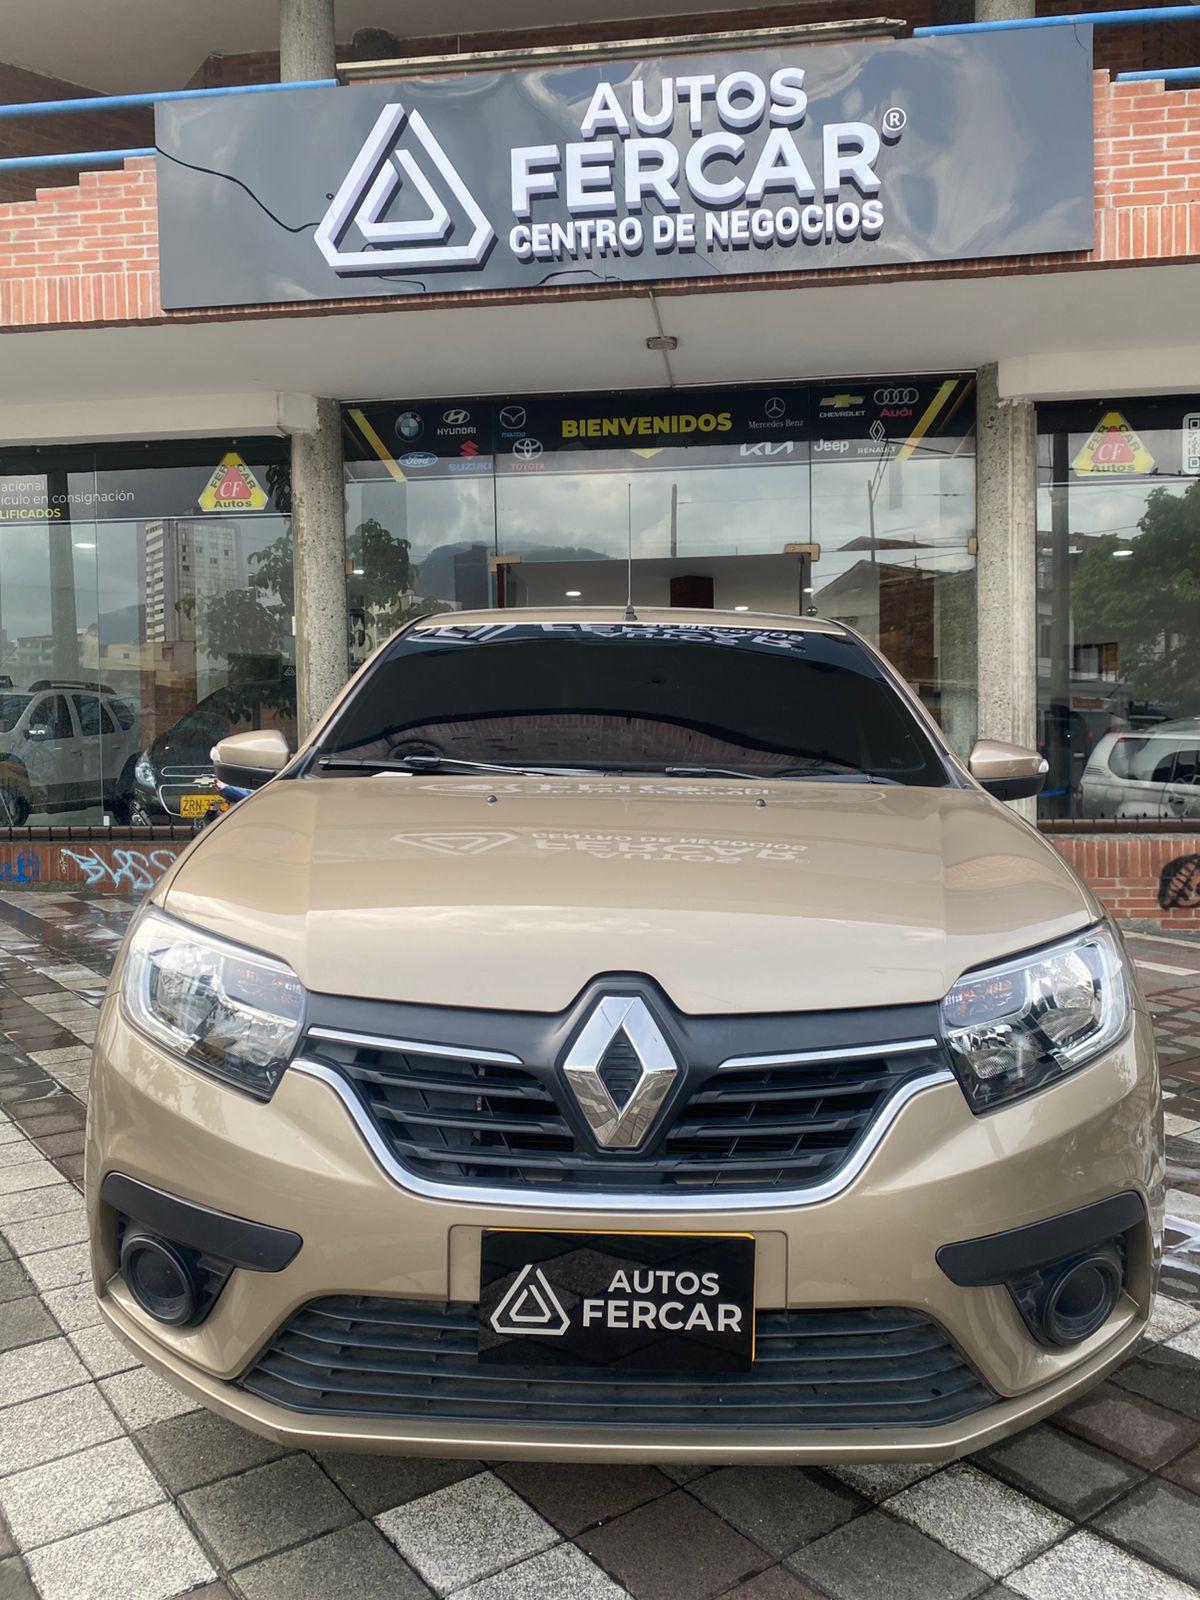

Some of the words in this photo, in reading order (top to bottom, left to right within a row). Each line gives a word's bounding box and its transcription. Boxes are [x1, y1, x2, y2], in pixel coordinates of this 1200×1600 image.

[580, 67, 808, 138] AUTOS
[511, 122, 881, 218] FERCAR
[509, 216, 643, 259] CENTRO
[653, 213, 696, 249] DE
[705, 200, 884, 248] NEGOCIOS
[818, 410, 866, 418] CHEVROLET
[437, 426, 477, 436] HYUNDAI
[561, 412, 733, 438] BIENVENIDOS
[748, 419, 804, 430] Mercedes-Benz
[740, 440, 794, 456] KIA
[813, 439, 849, 453] Jeep
[857, 446, 897, 455] RENAULT
[1099, 443, 1125, 461] CF
[448, 462, 492, 472] SUZUKI
[511, 462, 546, 471] TOYOTA
[1090, 463, 1136, 473] Autos
[210, 464, 229, 489] FER
[236, 463, 256, 489] CAR
[220, 481, 242, 497] CF
[33, 495, 48, 504] en
[52, 490, 135, 505] consignación
[214, 500, 252, 508] Autos
[607, 1269, 720, 1297] AUTOS
[582, 1299, 743, 1332] FERCAR
